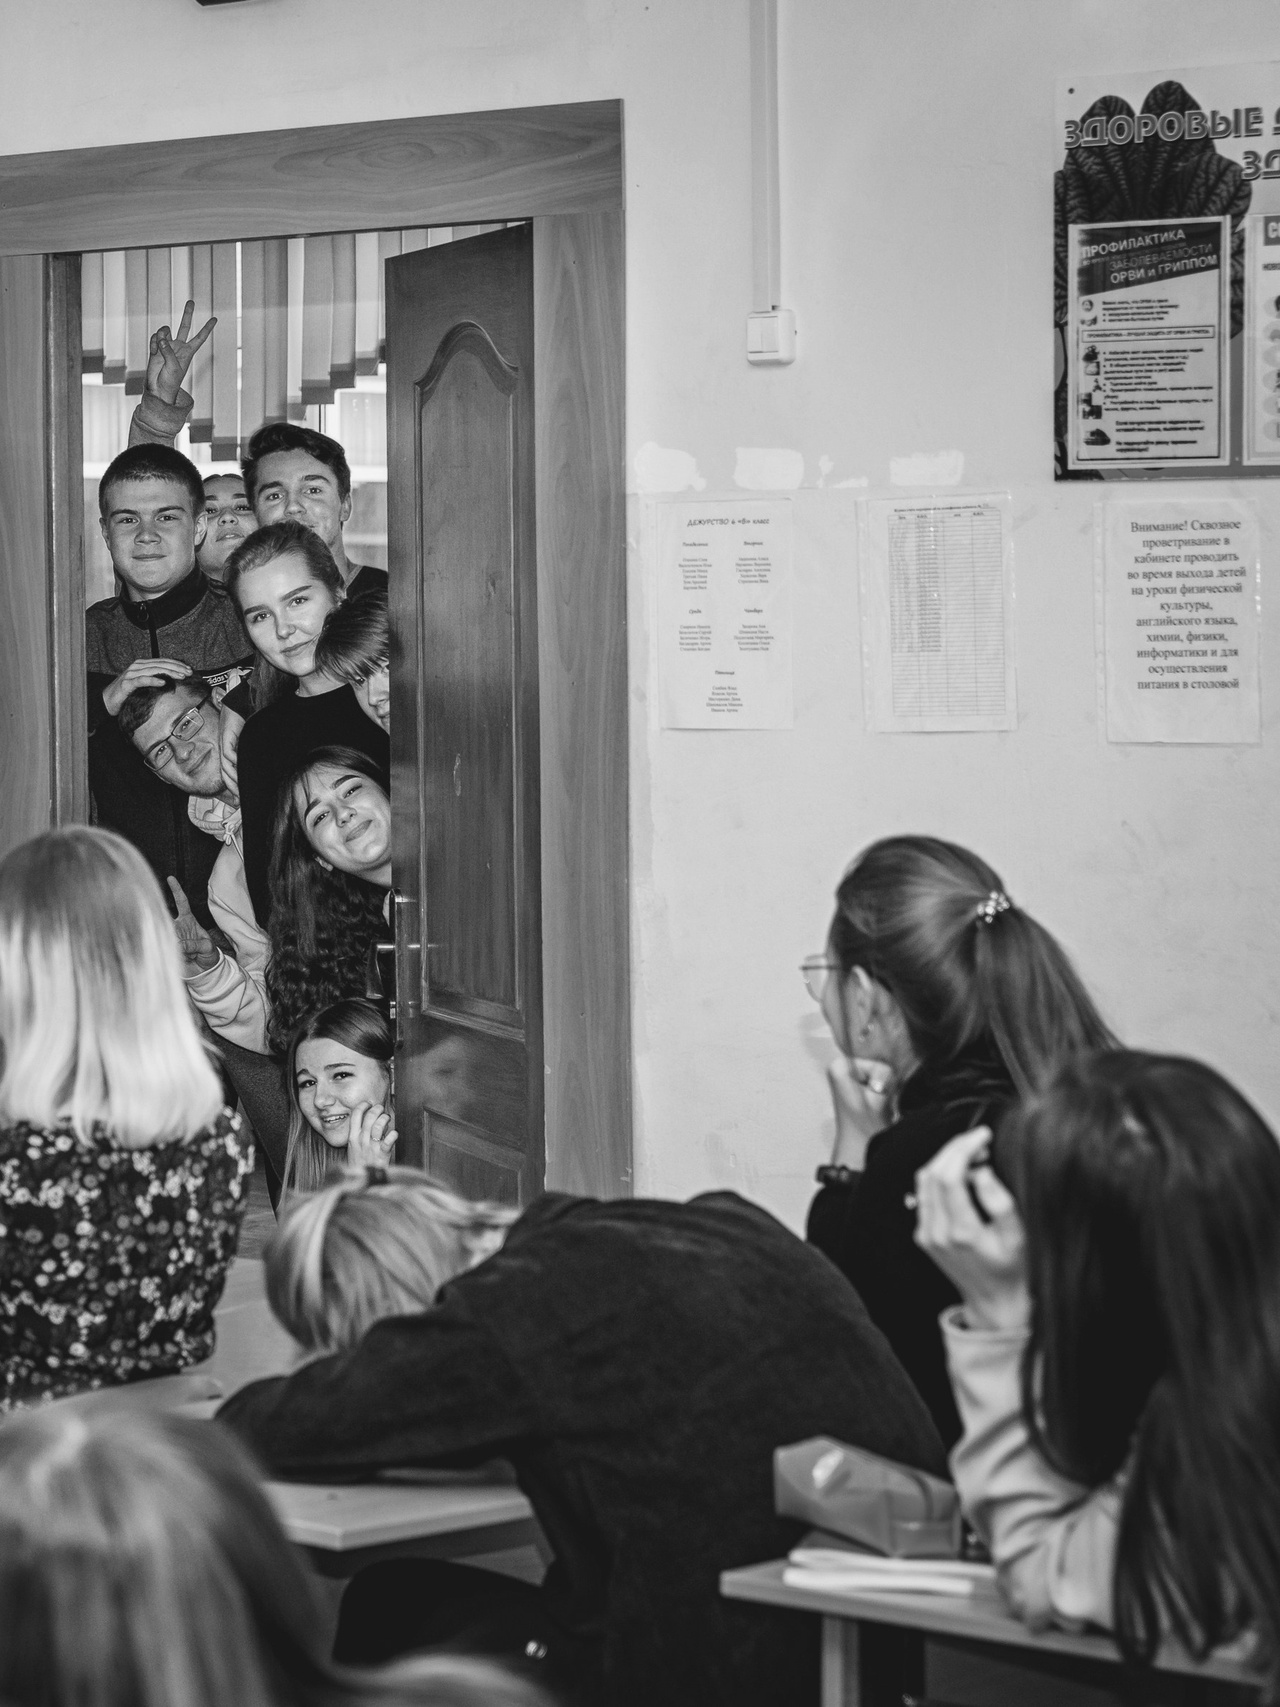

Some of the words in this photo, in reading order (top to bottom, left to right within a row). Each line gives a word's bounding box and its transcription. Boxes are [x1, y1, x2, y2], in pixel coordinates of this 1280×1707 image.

[1064, 106, 1264, 150] ЗДОРОВЫЕ
[1081, 228, 1186, 258] ПРОФИЛАКТИКА
[1109, 243, 1213, 271] ЗАБОЛЕВАЕМОСТИ
[1110, 267, 1146, 284] ОРВИ
[1147, 268, 1156, 277] и
[1157, 254, 1218, 275] ГРИППОМ
[687, 518, 730, 527] ДЕЖУРСТВО
[1131, 520, 1188, 532] Внимание!
[1190, 520, 1242, 531] Сквозное
[1142, 538, 1220, 550] проветривание
[1223, 538, 1231, 546] в
[1134, 553, 1181, 564] кабинете
[1183, 553, 1240, 565] проводить
[1127, 571, 1139, 580] во
[1142, 570, 1173, 582] время
[1175, 569, 1214, 580] выхода
[1216, 566, 1247, 579] детей
[1131, 587, 1144, 596] на
[1146, 586, 1178, 598] уроки
[1180, 582, 1243, 598] физической
[1160, 601, 1213, 613] культуры,
[1136, 616, 1202, 628] английского
[1204, 616, 1238, 627] языка,
[1146, 633, 1184, 643] химии,
[1186, 631, 1229, 644] физики,
[1136, 647, 1208, 661] информатики
[1210, 649, 1218, 658] и
[1220, 649, 1239, 659] для
[1148, 664, 1228, 676] осуществления
[1137, 680, 1180, 690] питания
[1182, 680, 1189, 689] в
[1190, 678, 1240, 690] столовой
